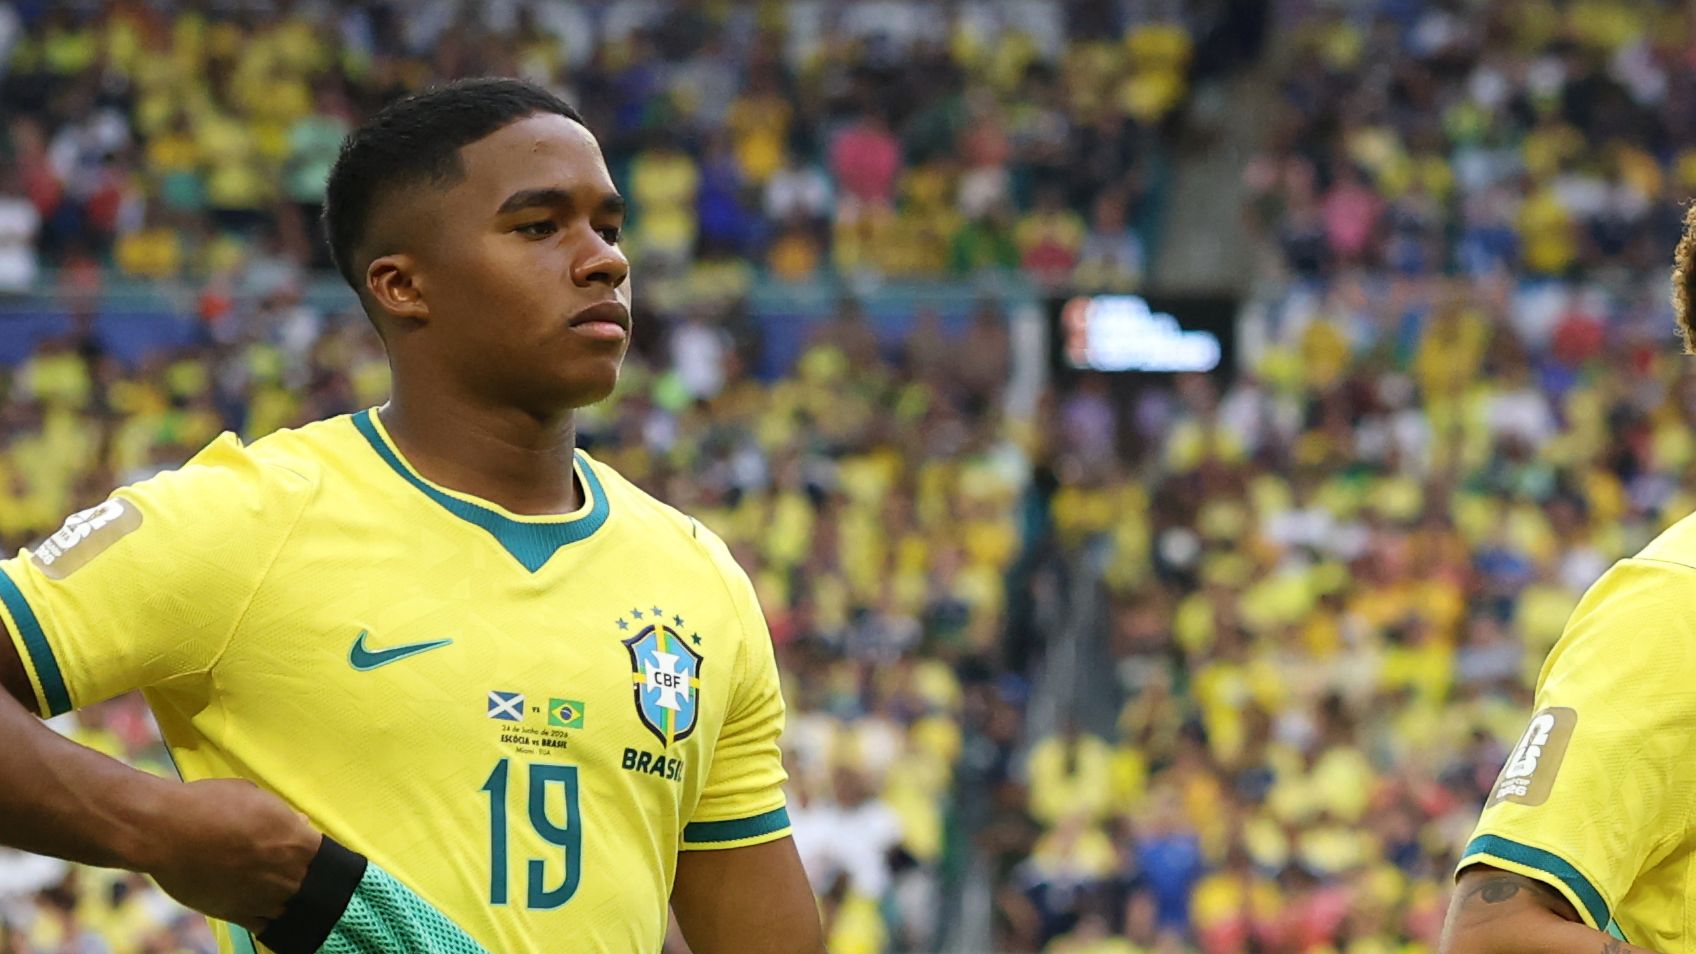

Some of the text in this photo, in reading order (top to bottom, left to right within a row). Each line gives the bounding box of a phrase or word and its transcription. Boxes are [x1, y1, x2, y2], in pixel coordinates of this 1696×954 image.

[654, 671, 681, 689] CBF
[541, 738, 568, 749] BRASIL
[480, 758, 582, 909] 19
